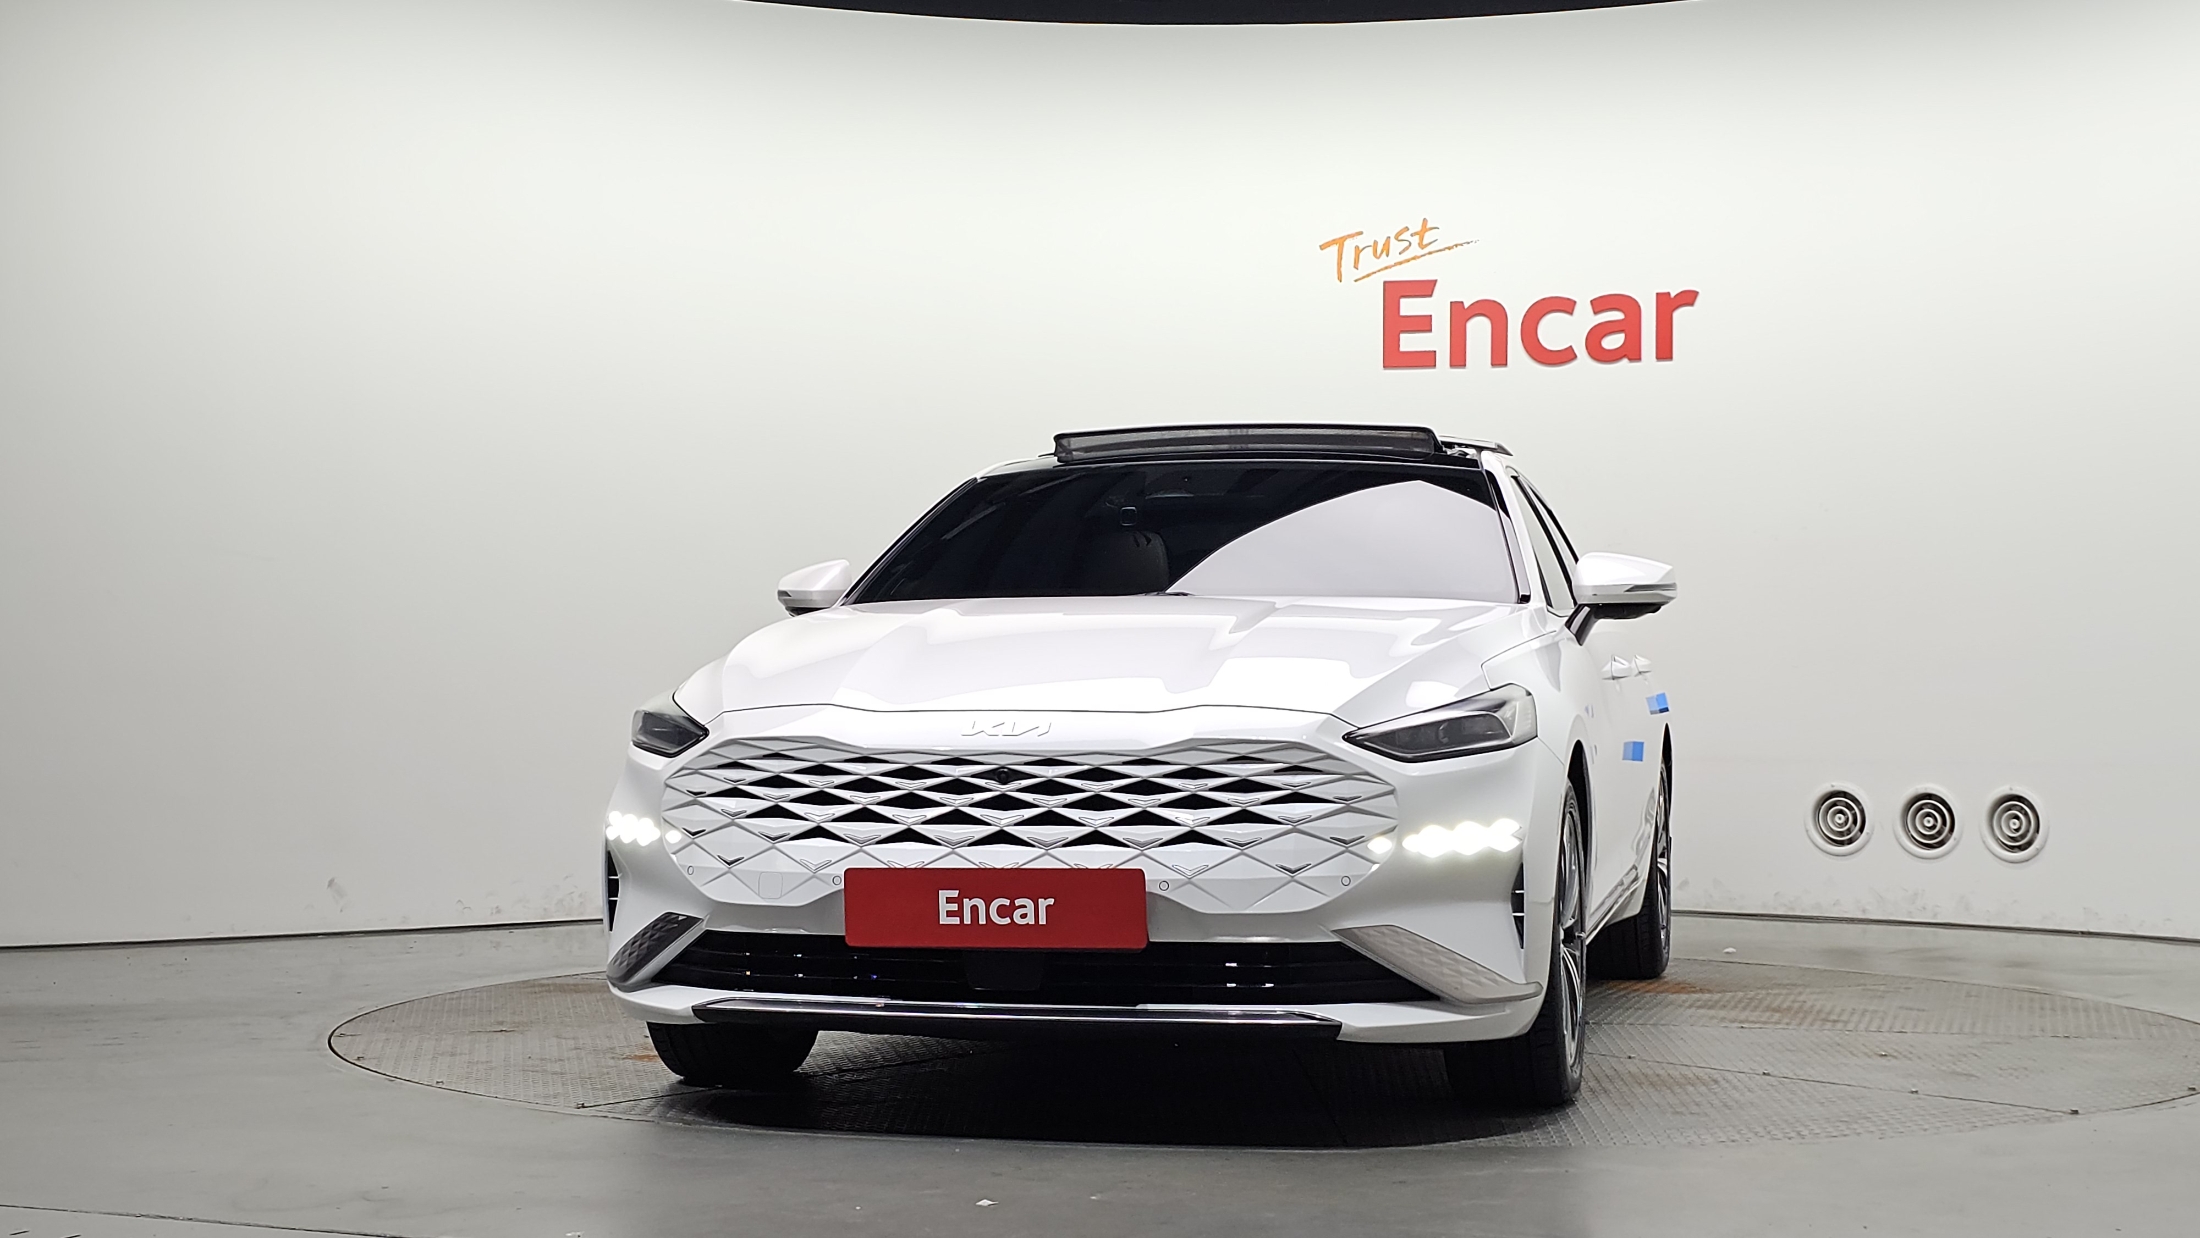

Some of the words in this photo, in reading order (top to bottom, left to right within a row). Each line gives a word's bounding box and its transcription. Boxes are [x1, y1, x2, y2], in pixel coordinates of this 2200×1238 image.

[1319, 218, 1440, 282] Trust
[1383, 279, 1699, 369] Encar
[938, 889, 1055, 925] Encar
